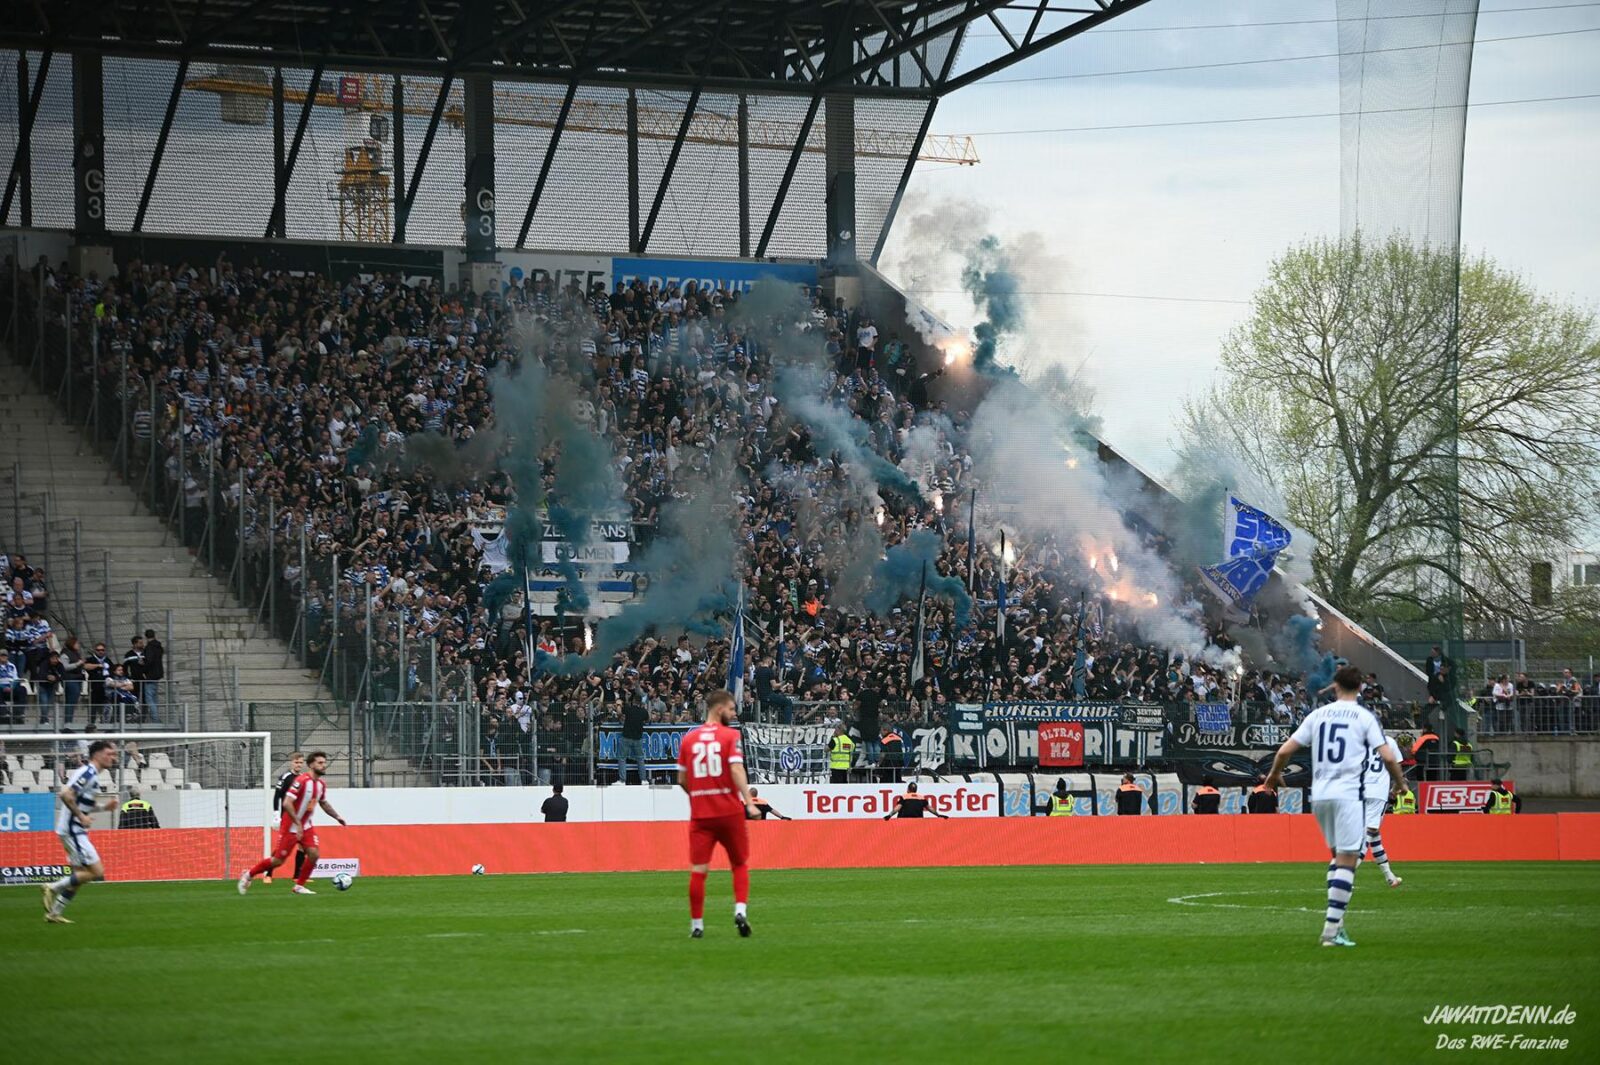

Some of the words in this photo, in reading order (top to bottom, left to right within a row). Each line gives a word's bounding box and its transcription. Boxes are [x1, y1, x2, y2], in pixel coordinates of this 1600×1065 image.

[85, 169, 104, 193] G
[88, 196, 102, 218] 3
[480, 215, 492, 236] 3
[746, 727, 836, 745] RUHRPOTT
[953, 728, 1164, 759] KOHRTE
[1040, 727, 1082, 742] ULTRAS
[1318, 721, 1349, 764] 15
[692, 742, 723, 778] 26
[803, 788, 996, 813] TerraTrnsfer
[0, 807, 31, 831] de
